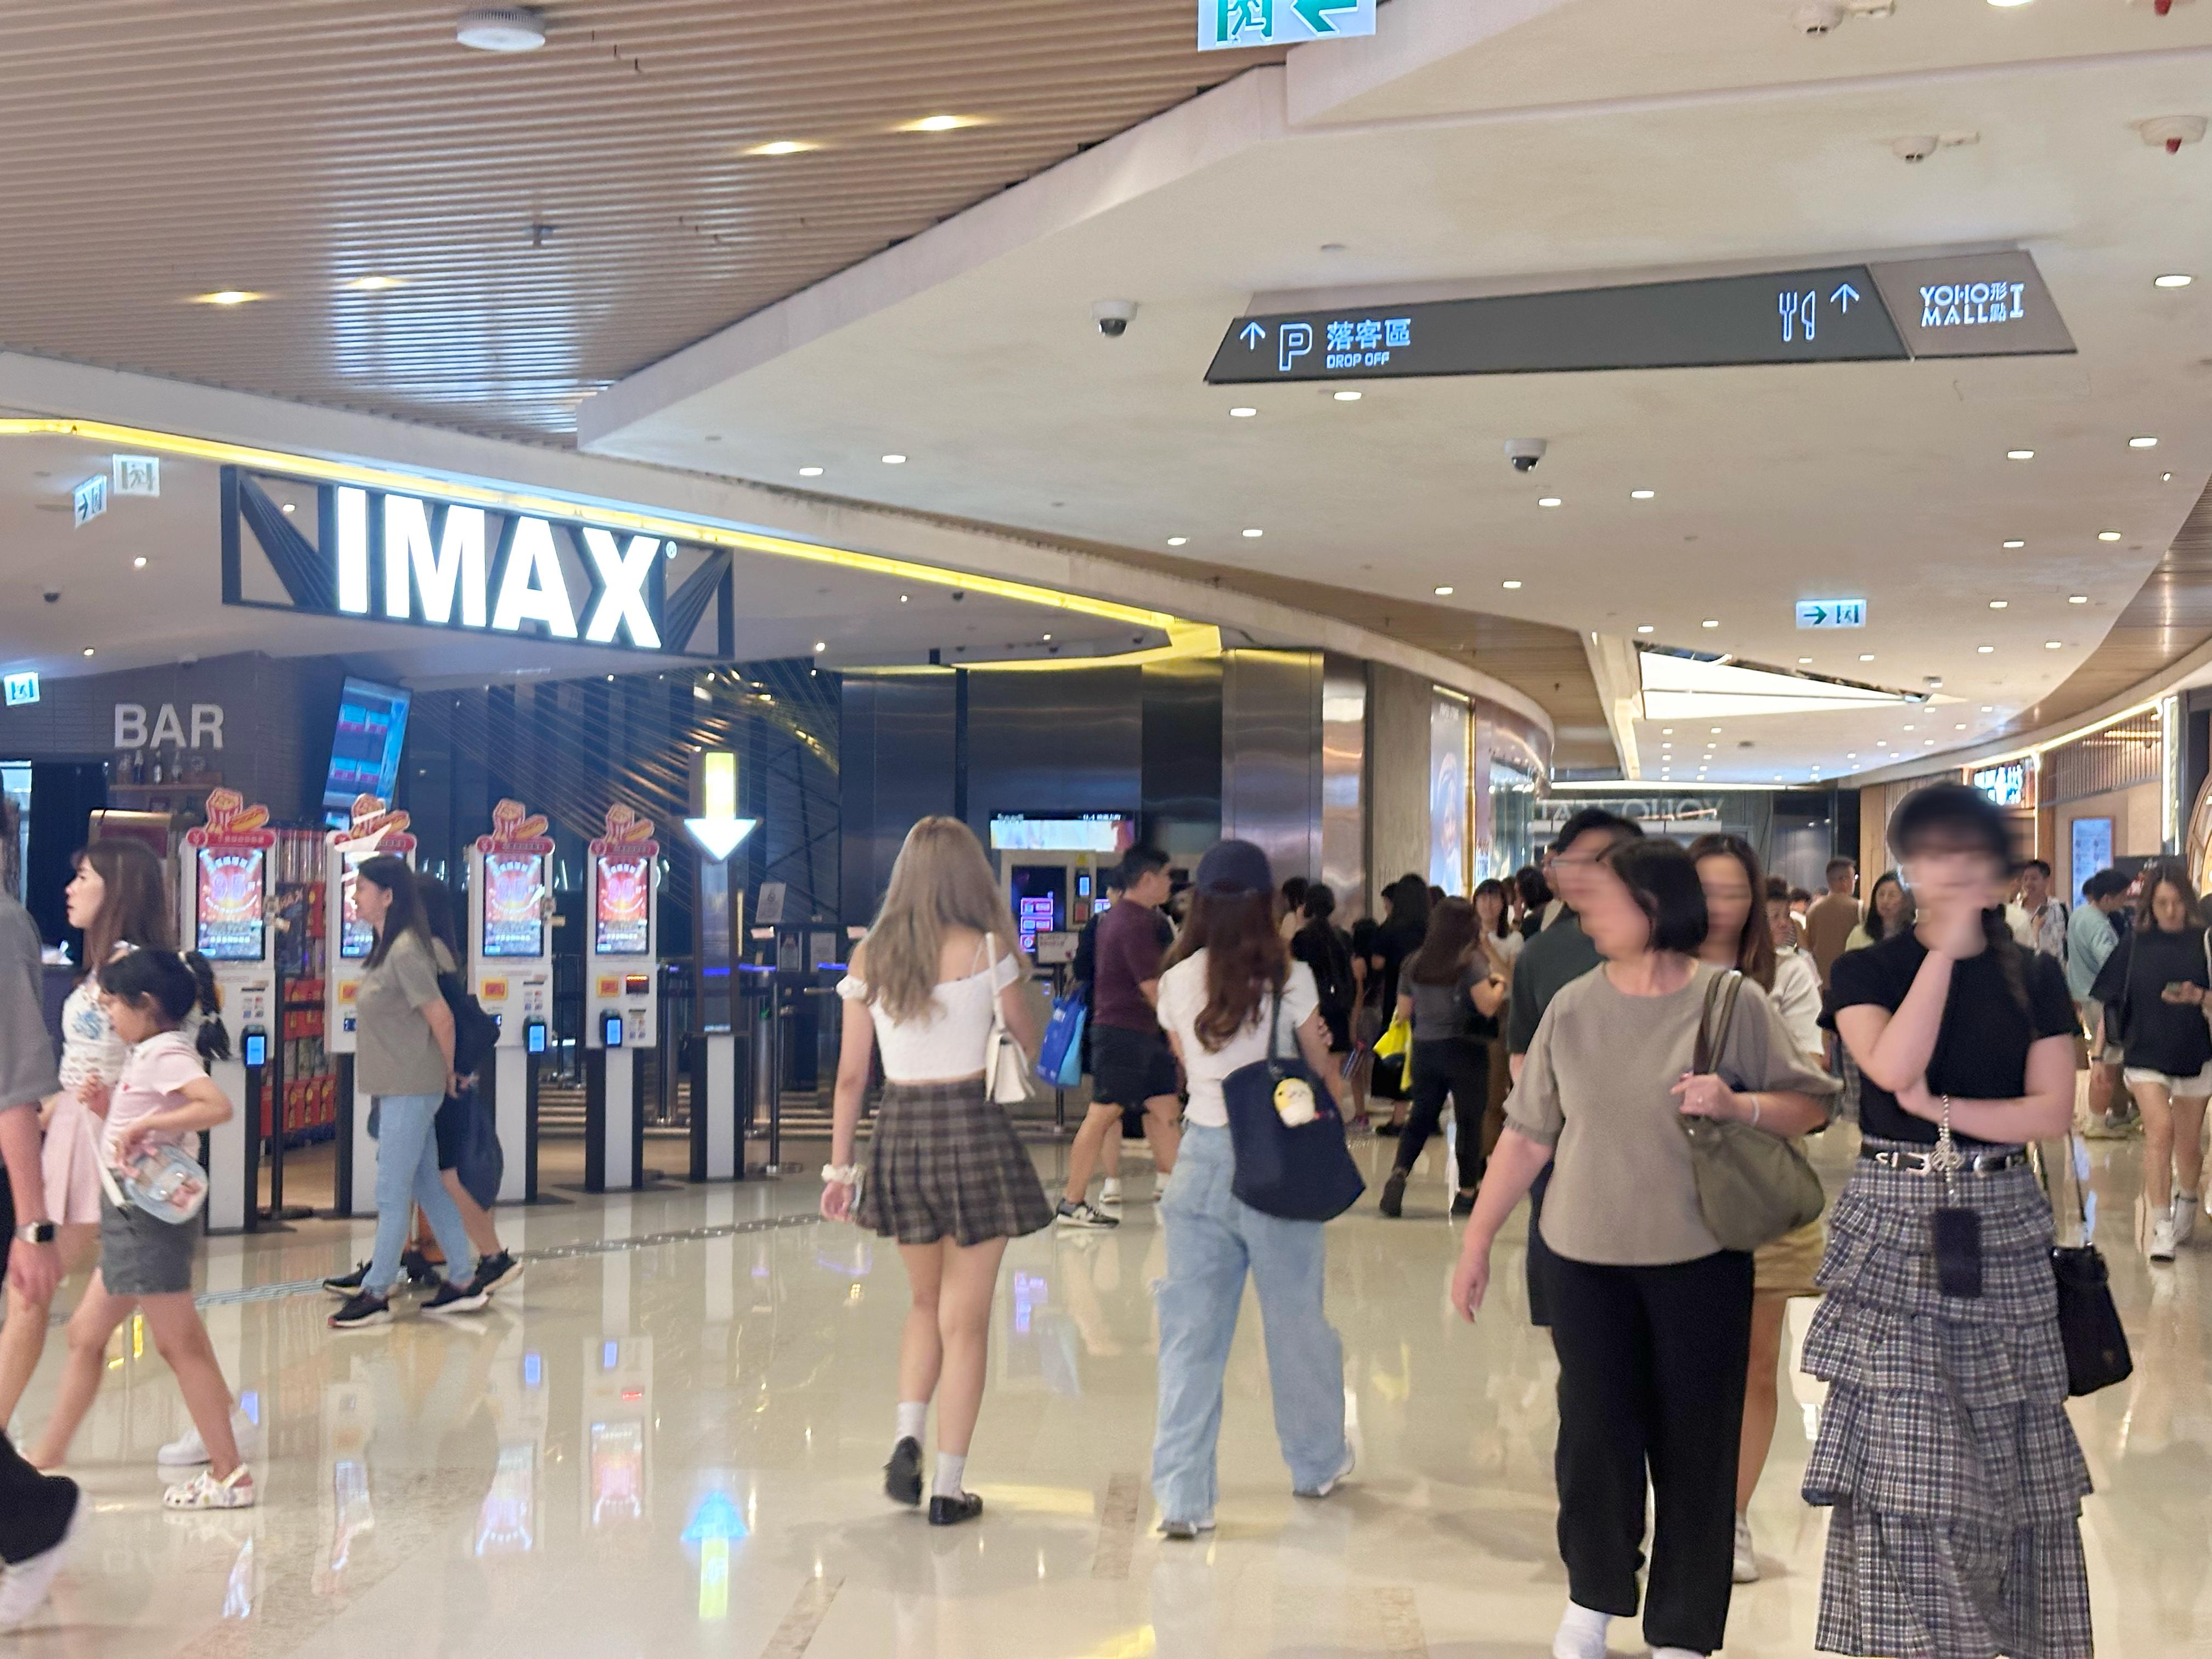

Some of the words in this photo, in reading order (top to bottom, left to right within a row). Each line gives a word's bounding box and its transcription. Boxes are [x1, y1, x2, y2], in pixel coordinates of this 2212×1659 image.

[1920, 283, 1990, 307] YOHO
[1921, 303, 1989, 328] MALL
[1326, 318, 1412, 351] 落客區
[1326, 353, 1362, 369] DROP
[1364, 351, 1390, 366] OFF
[337, 486, 662, 649] IMAX
[114, 703, 224, 748] BAR
